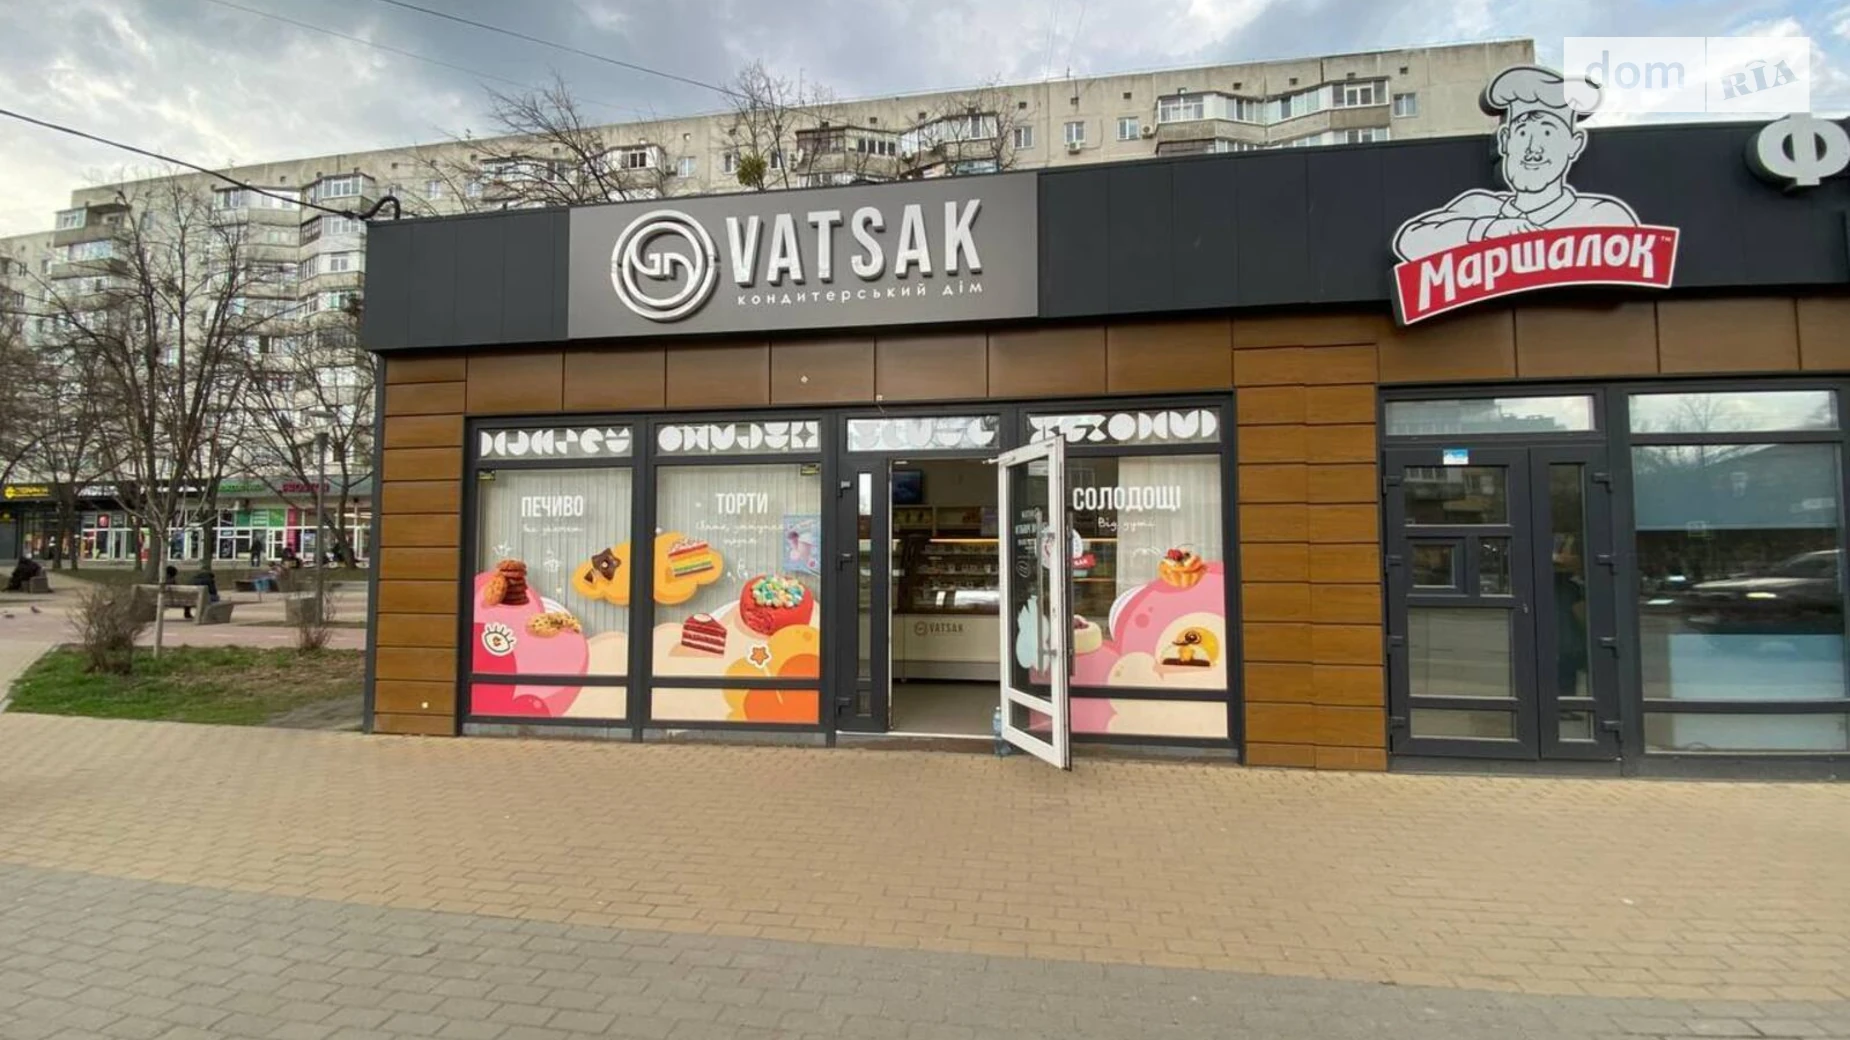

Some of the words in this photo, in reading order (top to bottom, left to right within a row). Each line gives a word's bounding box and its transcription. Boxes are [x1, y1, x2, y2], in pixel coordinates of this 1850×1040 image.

[1756, 112, 1850, 186] Ф
[726, 199, 982, 287] VATSAK
[1418, 234, 1656, 312] Маршалок
[738, 283, 927, 306] кондитерський
[943, 280, 983, 295] дім
[521, 495, 584, 517] ПЕЧИВО
[716, 493, 769, 515] ТОРТИ
[1073, 486, 1182, 512] СОЛОДОЩІ
